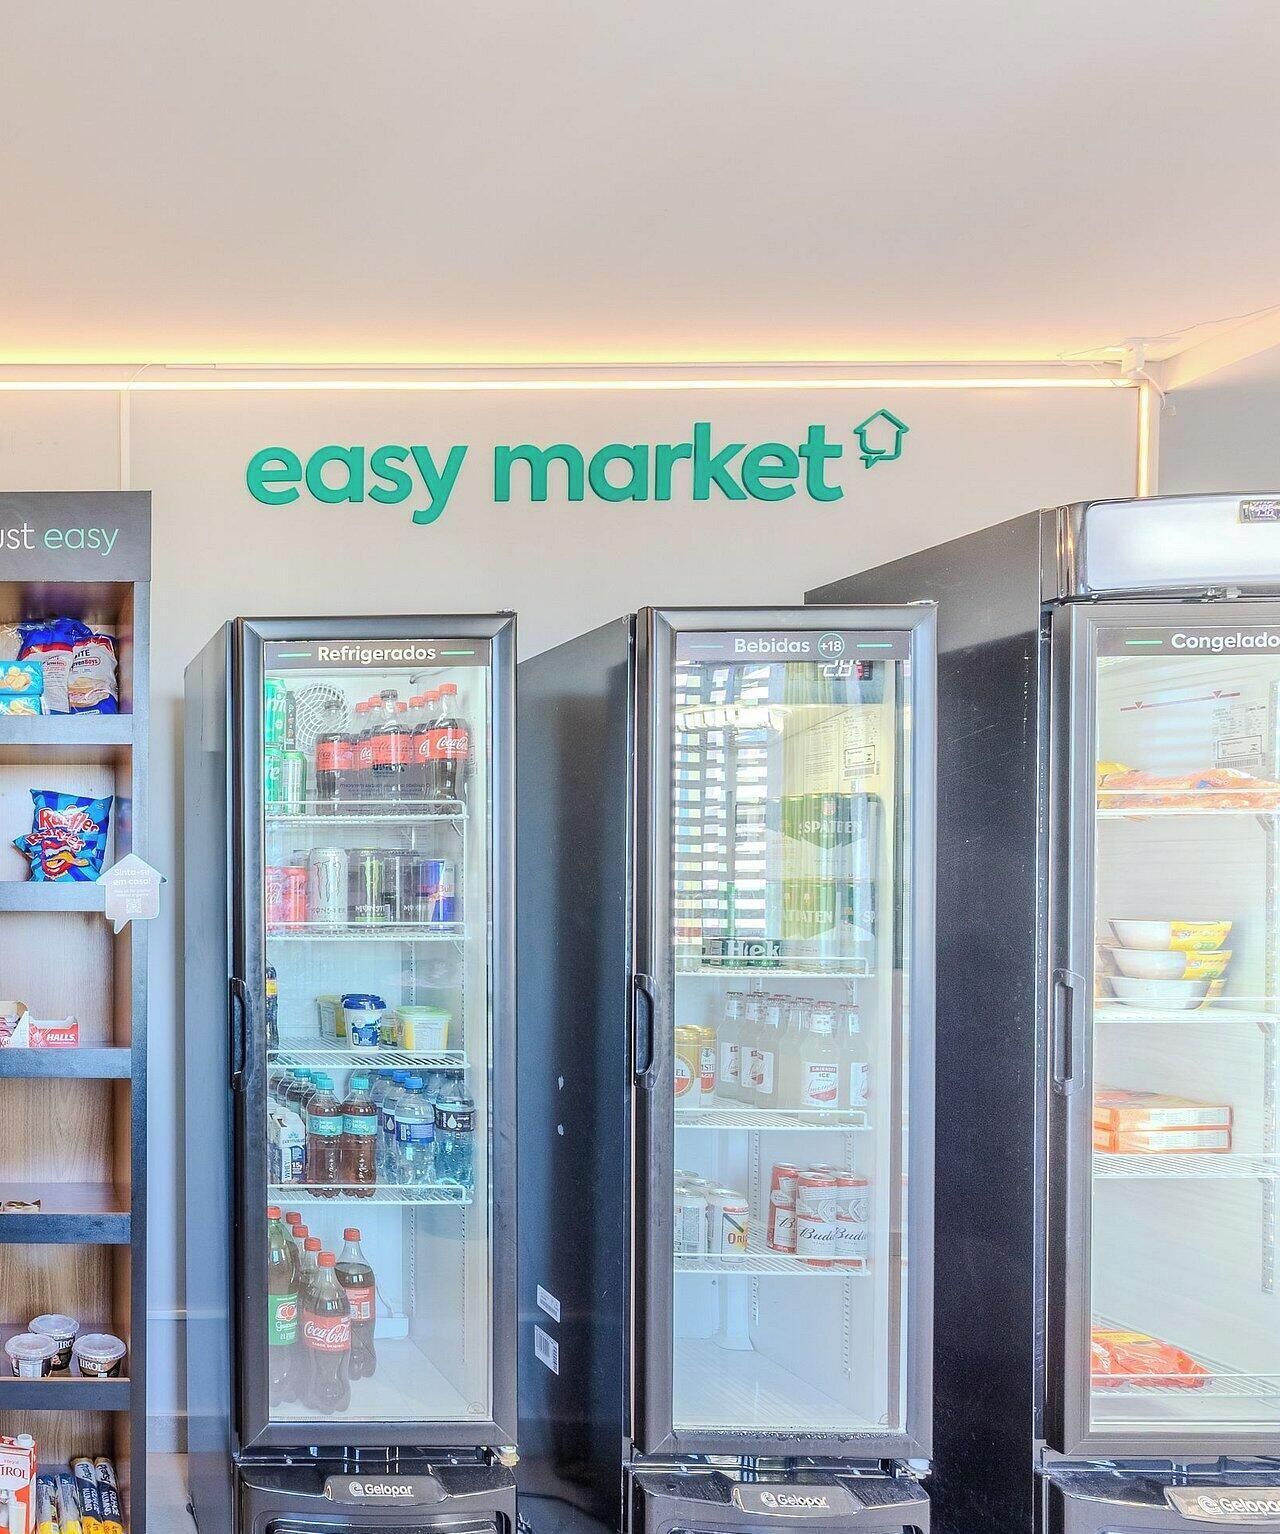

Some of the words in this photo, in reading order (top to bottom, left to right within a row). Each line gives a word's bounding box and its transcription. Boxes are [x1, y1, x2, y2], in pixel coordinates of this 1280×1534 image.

[246, 444, 468, 525] easy
[493, 422, 844, 503] market
[43, 527, 120, 556] easy
[734, 638, 811, 653] Bebidas
[819, 641, 843, 652] +18
[317, 646, 436, 664] Refrigerados
[39, 807, 99, 833] Ruffles
[46, 1033, 76, 1041] HALLS
[364, 1483, 413, 1497] Gelopar
[777, 1492, 827, 1508] Gelopar
